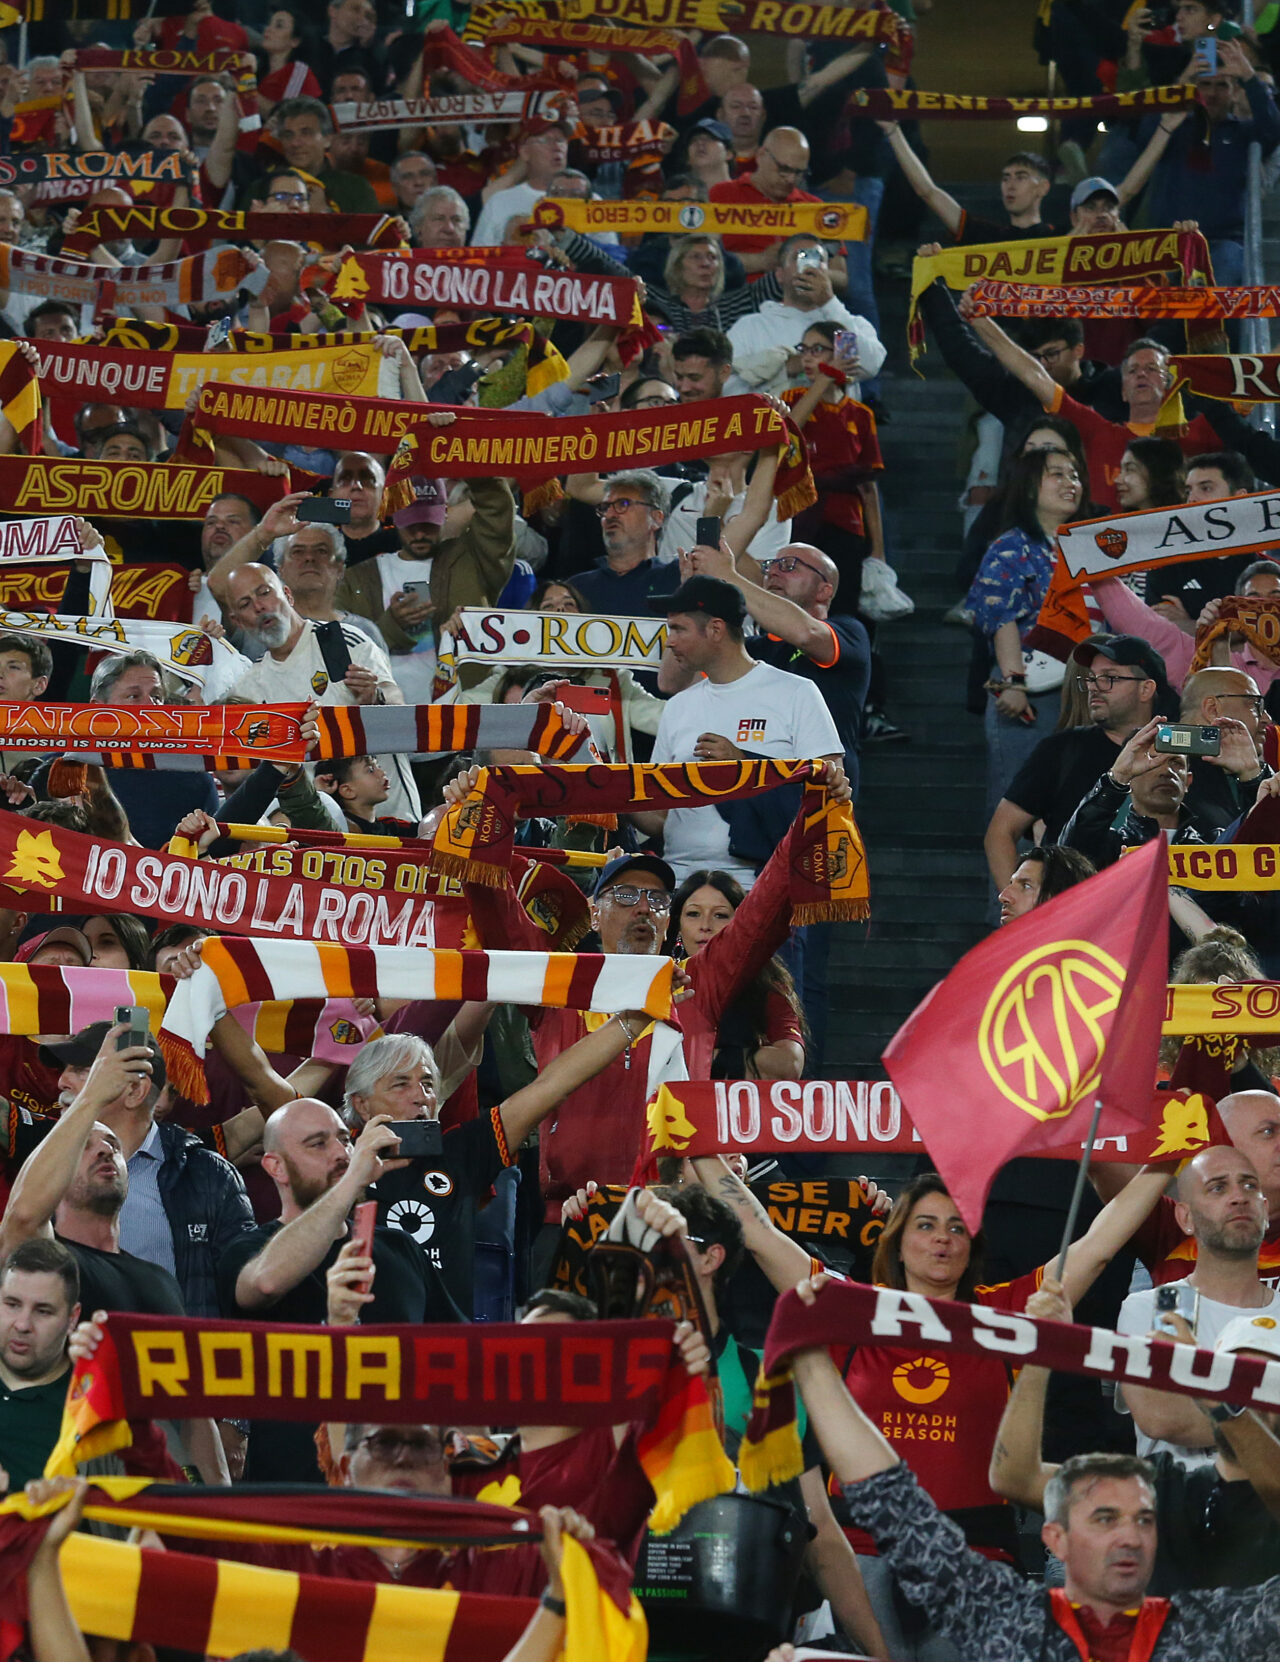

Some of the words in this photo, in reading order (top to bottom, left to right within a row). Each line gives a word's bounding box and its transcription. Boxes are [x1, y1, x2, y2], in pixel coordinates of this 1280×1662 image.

[750, 4, 877, 39] ROMA
[122, 49, 245, 71] ROMA
[44, 152, 185, 180] ROMA
[716, 205, 798, 229] TIRANA
[964, 249, 1057, 278] DAJE
[1070, 233, 1180, 273] ROMA
[382, 260, 410, 299] IO
[414, 263, 491, 306] SONO
[494, 269, 529, 309] LA
[533, 274, 617, 321] ROMA
[199, 387, 357, 434] CAMMINERÒ
[430, 426, 599, 465] CAMMINERÒ
[606, 416, 719, 458] INSIEME
[724, 411, 743, 441] A
[753, 407, 785, 434] TE
[14, 463, 226, 514] ASROMA
[1155, 506, 1237, 549] AS
[73, 738, 90, 749] SI
[95, 739, 131, 749] NON
[479, 804, 496, 843] ROMA
[814, 843, 824, 884] ROMA
[1168, 848, 1237, 880] ICO
[83, 843, 127, 899] IO
[130, 857, 248, 926] SONO
[250, 877, 305, 936] LA
[311, 887, 436, 948] ROMA
[715, 1081, 762, 1144] IO
[771, 1080, 903, 1145] SONO
[130, 1329, 401, 1401] ROMA
[882, 1411, 958, 1428] RIYADH
[882, 1426, 958, 1444] SEASON
[645, 1588, 688, 1599] PASSIONE
